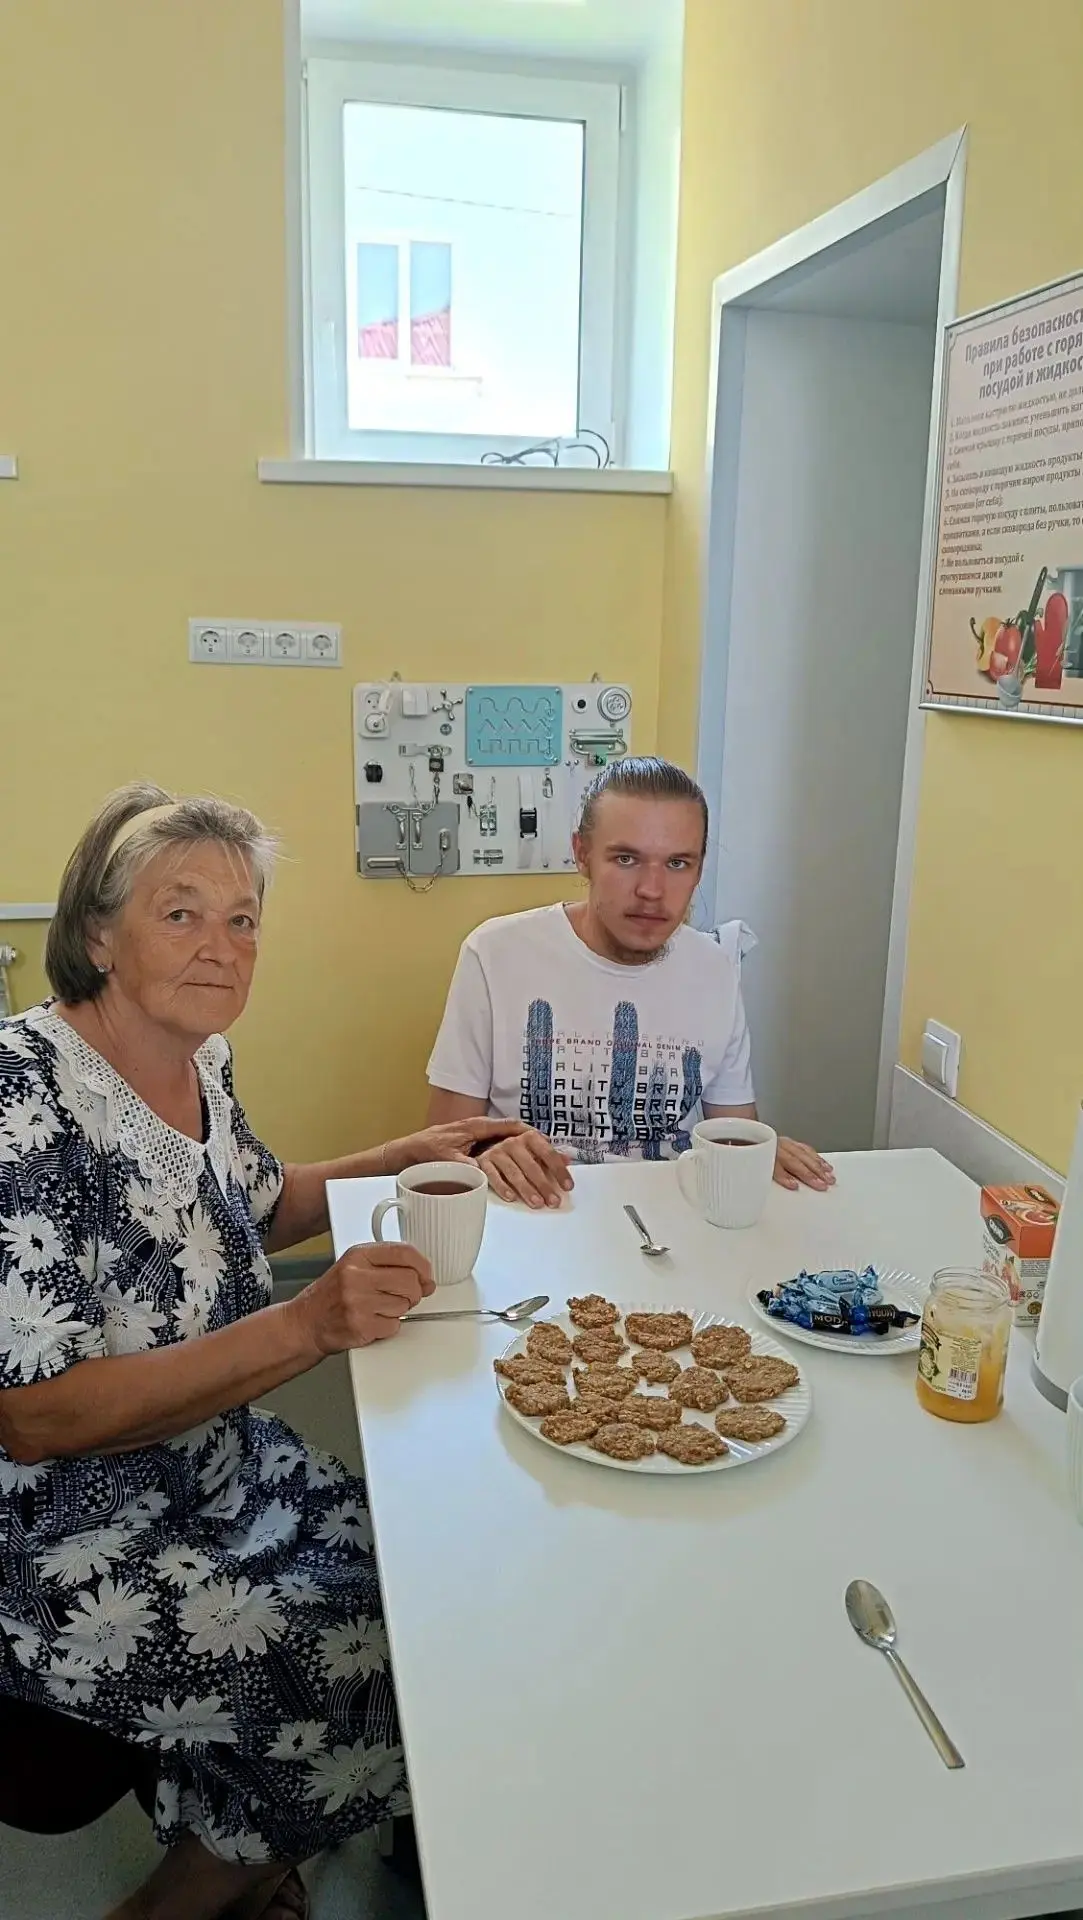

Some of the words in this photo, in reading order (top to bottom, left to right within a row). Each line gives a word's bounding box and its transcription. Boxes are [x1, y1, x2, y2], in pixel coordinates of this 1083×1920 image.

[965, 333, 1009, 364] Правила
[983, 358, 1004, 379] при
[1004, 344, 1045, 375] работе
[1046, 341, 1053, 357] с
[979, 368, 1024, 400] посудой
[1025, 371, 1034, 386] и
[1036, 519, 1047, 530] без
[566, 1038, 602, 1046] BRAND
[656, 1043, 681, 1051] DENIM
[520, 1077, 625, 1093] QUALITY
[636, 1082, 703, 1097] BRAND
[520, 1093, 624, 1111] QUALITY
[519, 1108, 624, 1126] QUALITY
